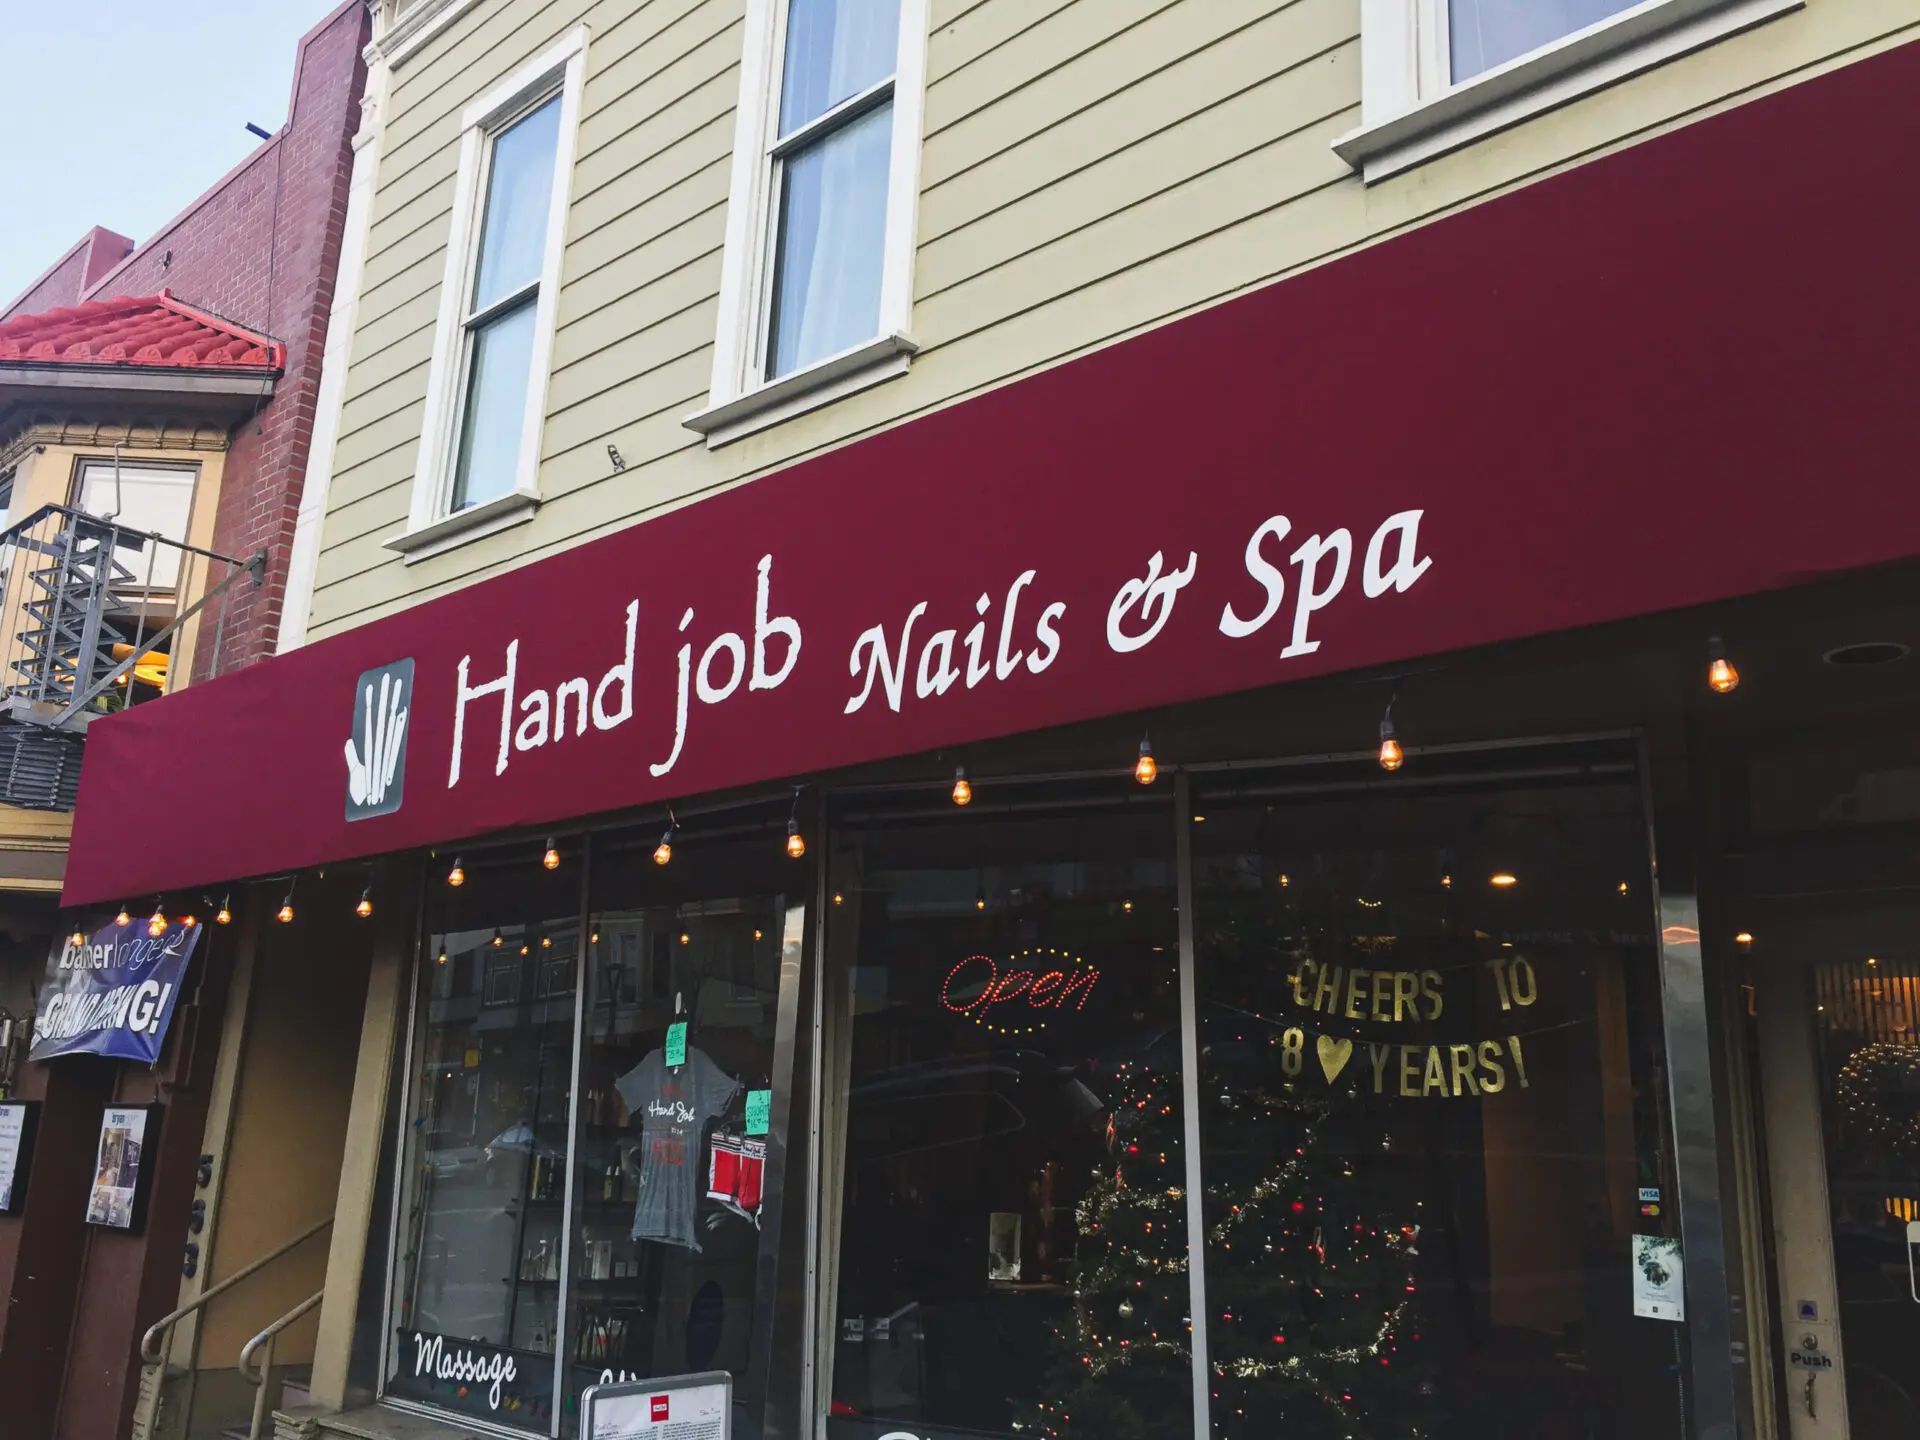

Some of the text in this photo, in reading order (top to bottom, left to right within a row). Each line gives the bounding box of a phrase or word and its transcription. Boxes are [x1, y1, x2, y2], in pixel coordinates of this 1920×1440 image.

[448, 509, 1432, 788] Hand job Nails & Spa
[942, 955, 1100, 1019] Open
[1293, 955, 1538, 1022] CHEERS TO
[1281, 1027, 1529, 1098] 8 YEARS!
[648, 1098, 695, 1123] Hand Job
[1641, 1190, 1659, 1198] VISA
[414, 1332, 517, 1411] Massage
[1791, 1352, 1832, 1368] Push
